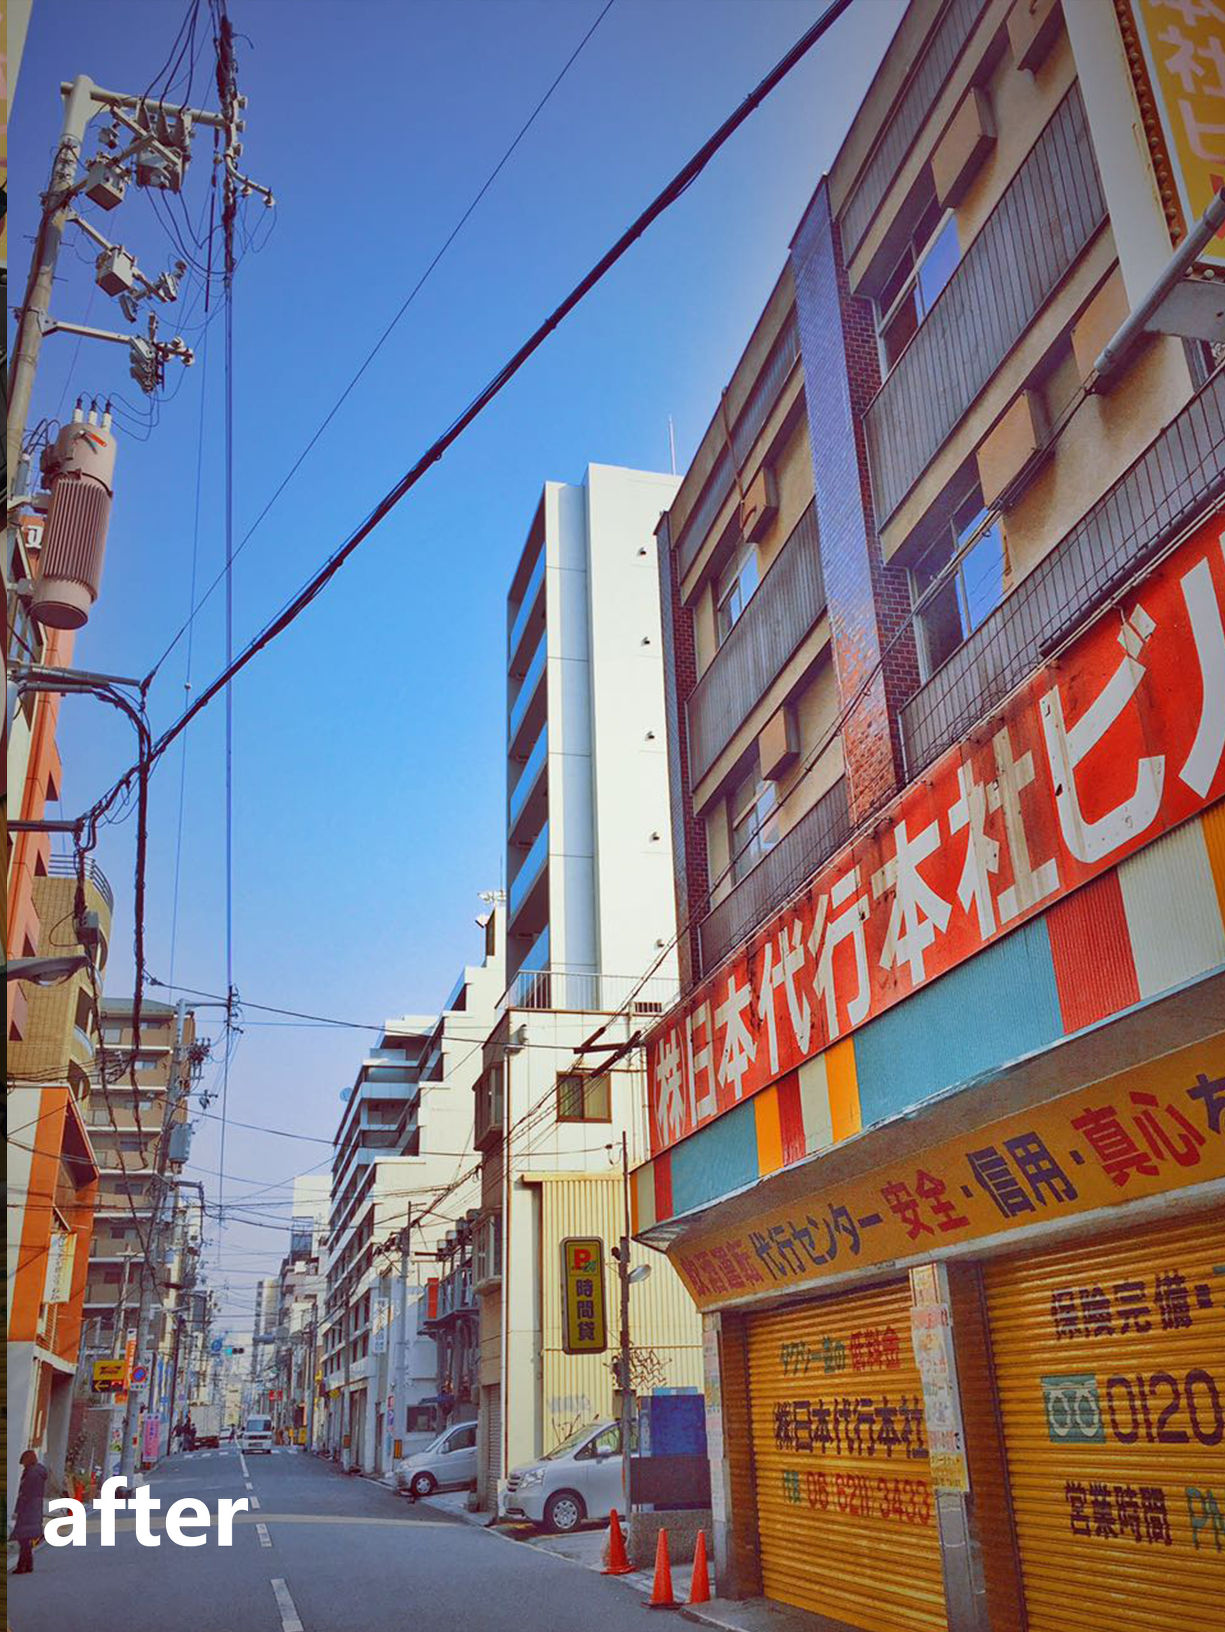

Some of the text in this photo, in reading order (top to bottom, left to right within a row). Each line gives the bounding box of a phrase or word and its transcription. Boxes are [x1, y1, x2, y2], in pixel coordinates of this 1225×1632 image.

[575, 1279, 595, 1341] 時間貸
[1063, 1480, 1173, 1546] 営業時間
